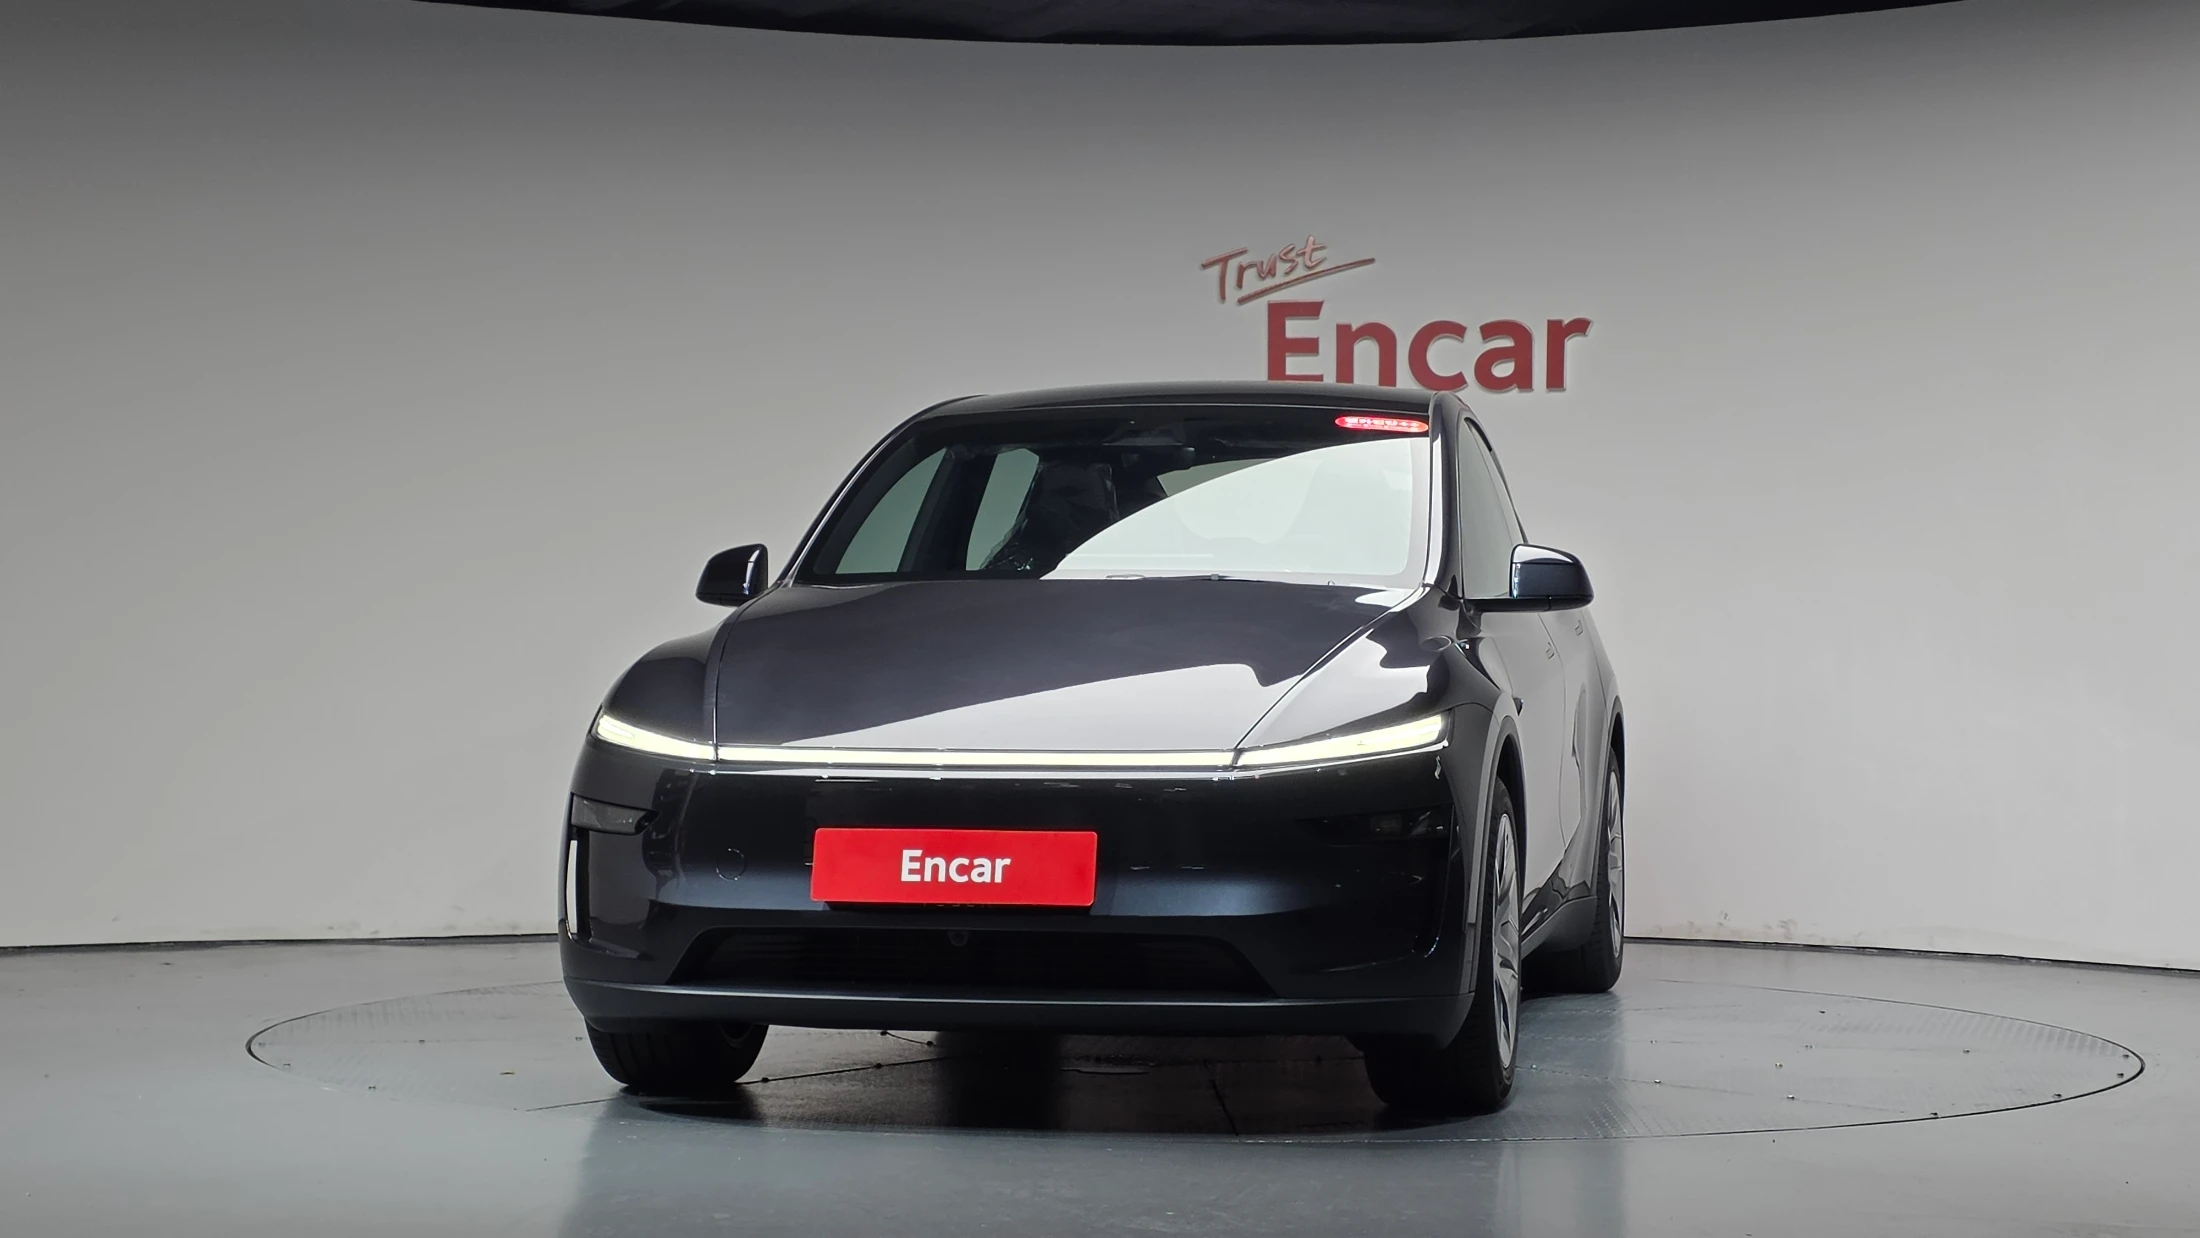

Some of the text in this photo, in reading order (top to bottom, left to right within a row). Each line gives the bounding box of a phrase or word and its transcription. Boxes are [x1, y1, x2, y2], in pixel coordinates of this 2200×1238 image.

[1201, 235, 1328, 303] Trust
[1266, 299, 1593, 393] Encar
[901, 848, 1011, 883] Encar
